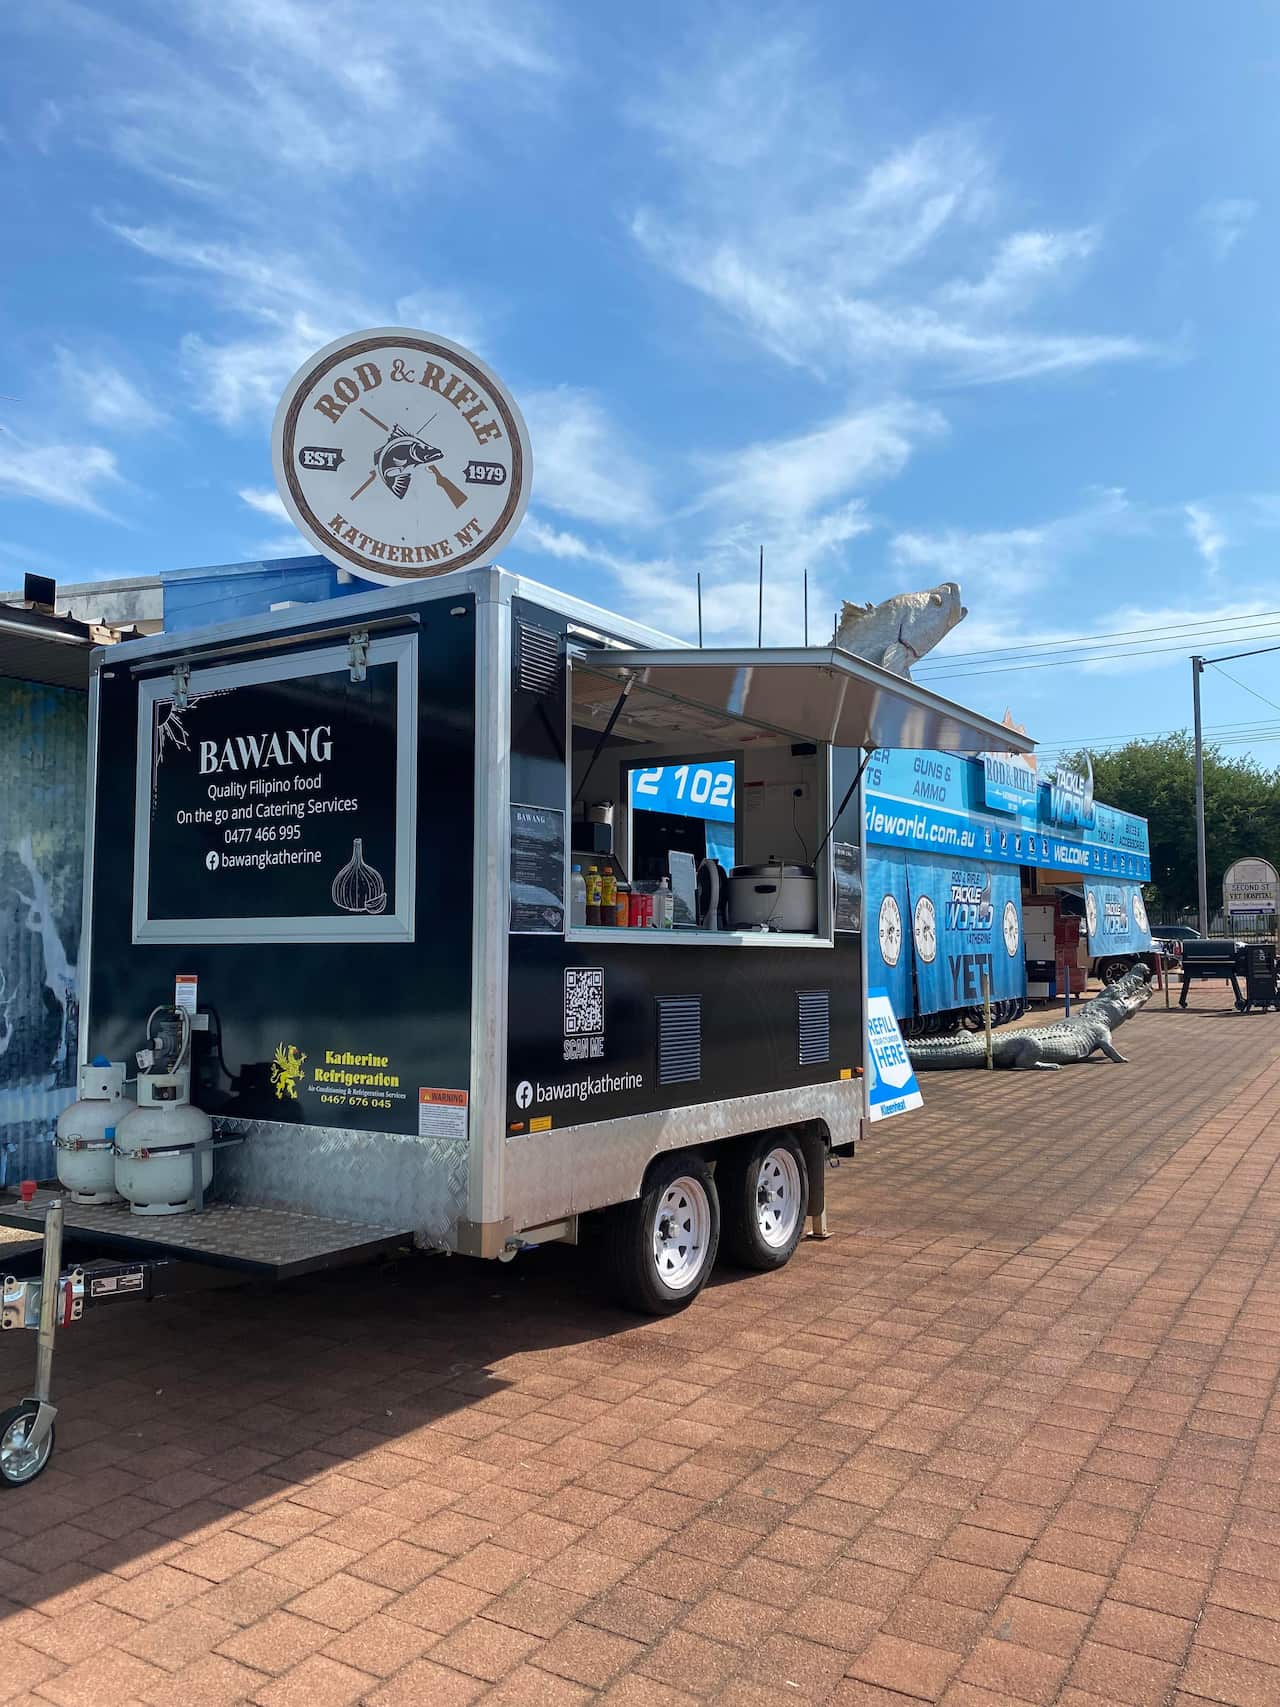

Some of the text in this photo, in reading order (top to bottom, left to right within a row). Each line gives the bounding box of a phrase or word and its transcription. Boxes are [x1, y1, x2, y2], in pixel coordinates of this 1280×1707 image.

[314, 358, 503, 446] ROD & RIFLE
[303, 450, 337, 467] EST
[467, 465, 504, 482] 1979
[327, 513, 485, 563] KATHERINE NT
[199, 725, 334, 774] BAWANG
[913, 757, 952, 782] GUNS &
[1055, 766, 1085, 795] TACKLE
[207, 773, 322, 801] Quality Filipino food
[636, 765, 735, 808] 2 102
[912, 780, 946, 802] AMMO
[176, 797, 358, 825] On the go and Catering Services
[516, 812, 546, 824] BAWANG
[1051, 785, 1096, 831] WORLD
[224, 825, 301, 844] 0477 466 995
[221, 848, 322, 870] bawangkatherine
[1053, 844, 1090, 867] WELCOME
[951, 885, 982, 903] TACKLE
[945, 902, 994, 931] WORLD
[948, 953, 995, 1001] YETI
[868, 1016, 897, 1036] REFILL
[325, 1050, 389, 1068] Katherine
[563, 1036, 605, 1060] SCAN ME
[875, 1044, 906, 1069] HERE
[314, 1068, 400, 1088] Refrigeration
[536, 1071, 643, 1103] bawangkatherine
[320, 1094, 392, 1109] 0467 676 045
[353, 1088, 385, 1098] Refrigeration
[385, 1091, 407, 1099] Services
[432, 1092, 464, 1103] WARNING
